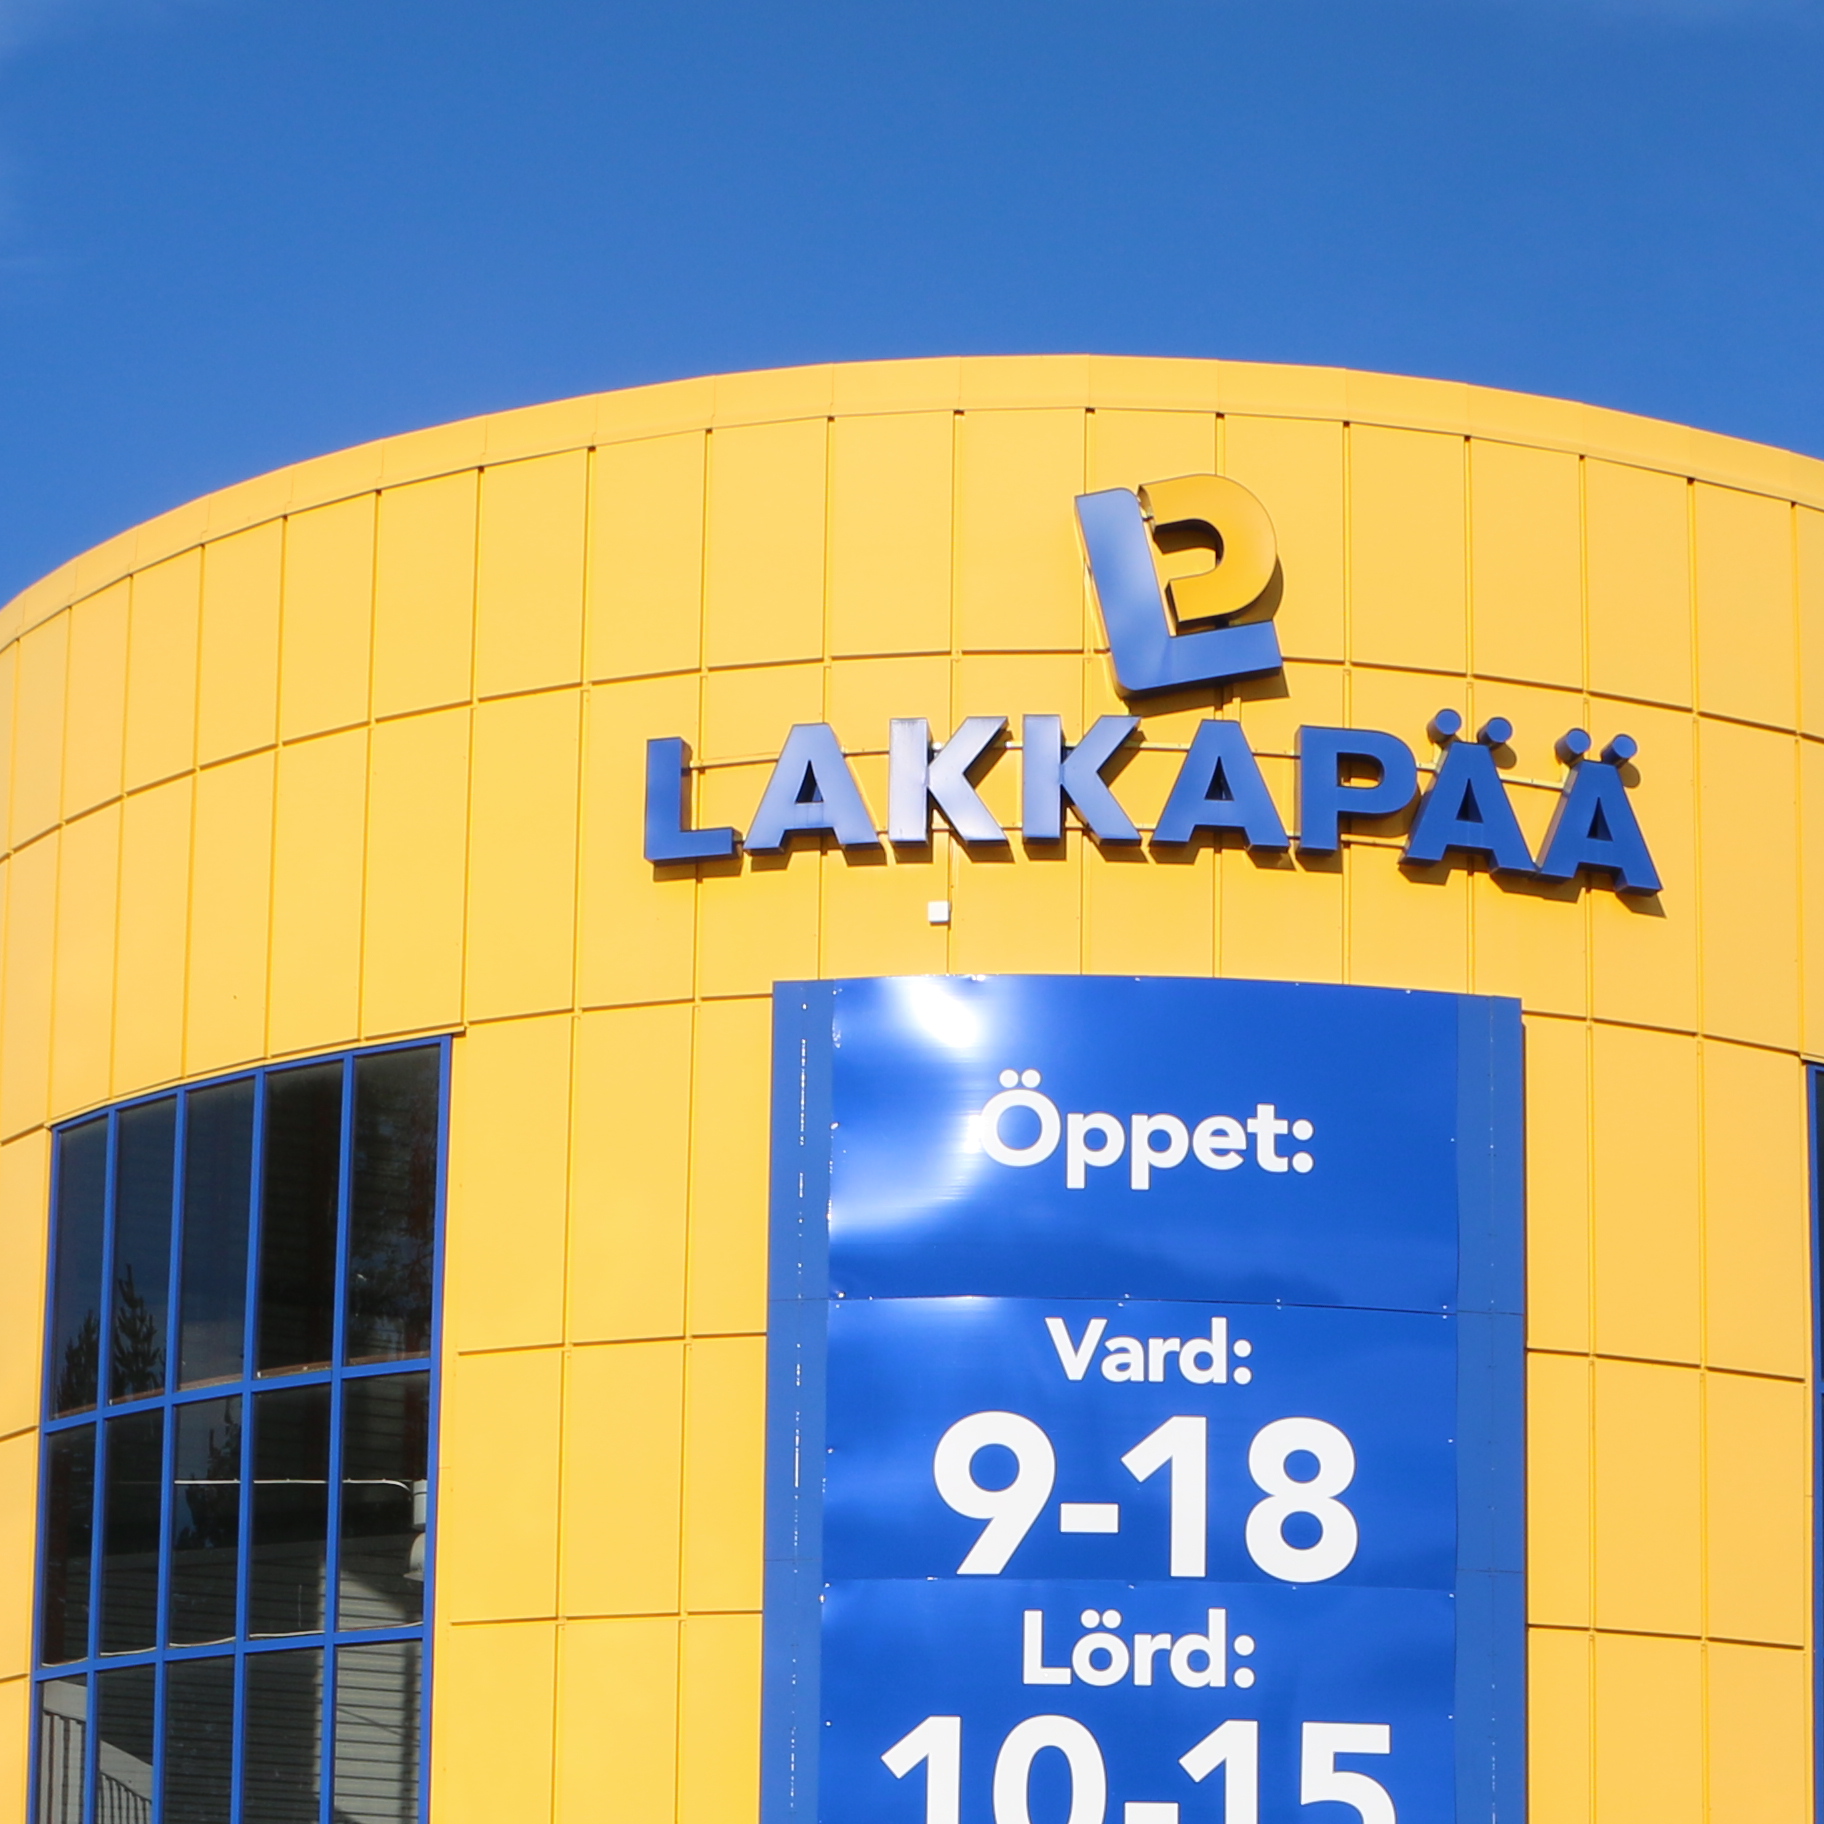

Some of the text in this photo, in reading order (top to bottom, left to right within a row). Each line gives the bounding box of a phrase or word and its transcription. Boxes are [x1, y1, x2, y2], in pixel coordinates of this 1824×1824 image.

[646, 709, 1663, 895] LAKKAPÄÄ
[979, 1068, 1316, 1191] Öppet:
[1045, 1317, 1253, 1386] Vard:
[933, 1410, 1358, 1583] 9-18
[1022, 1608, 1256, 1689] Lörd:
